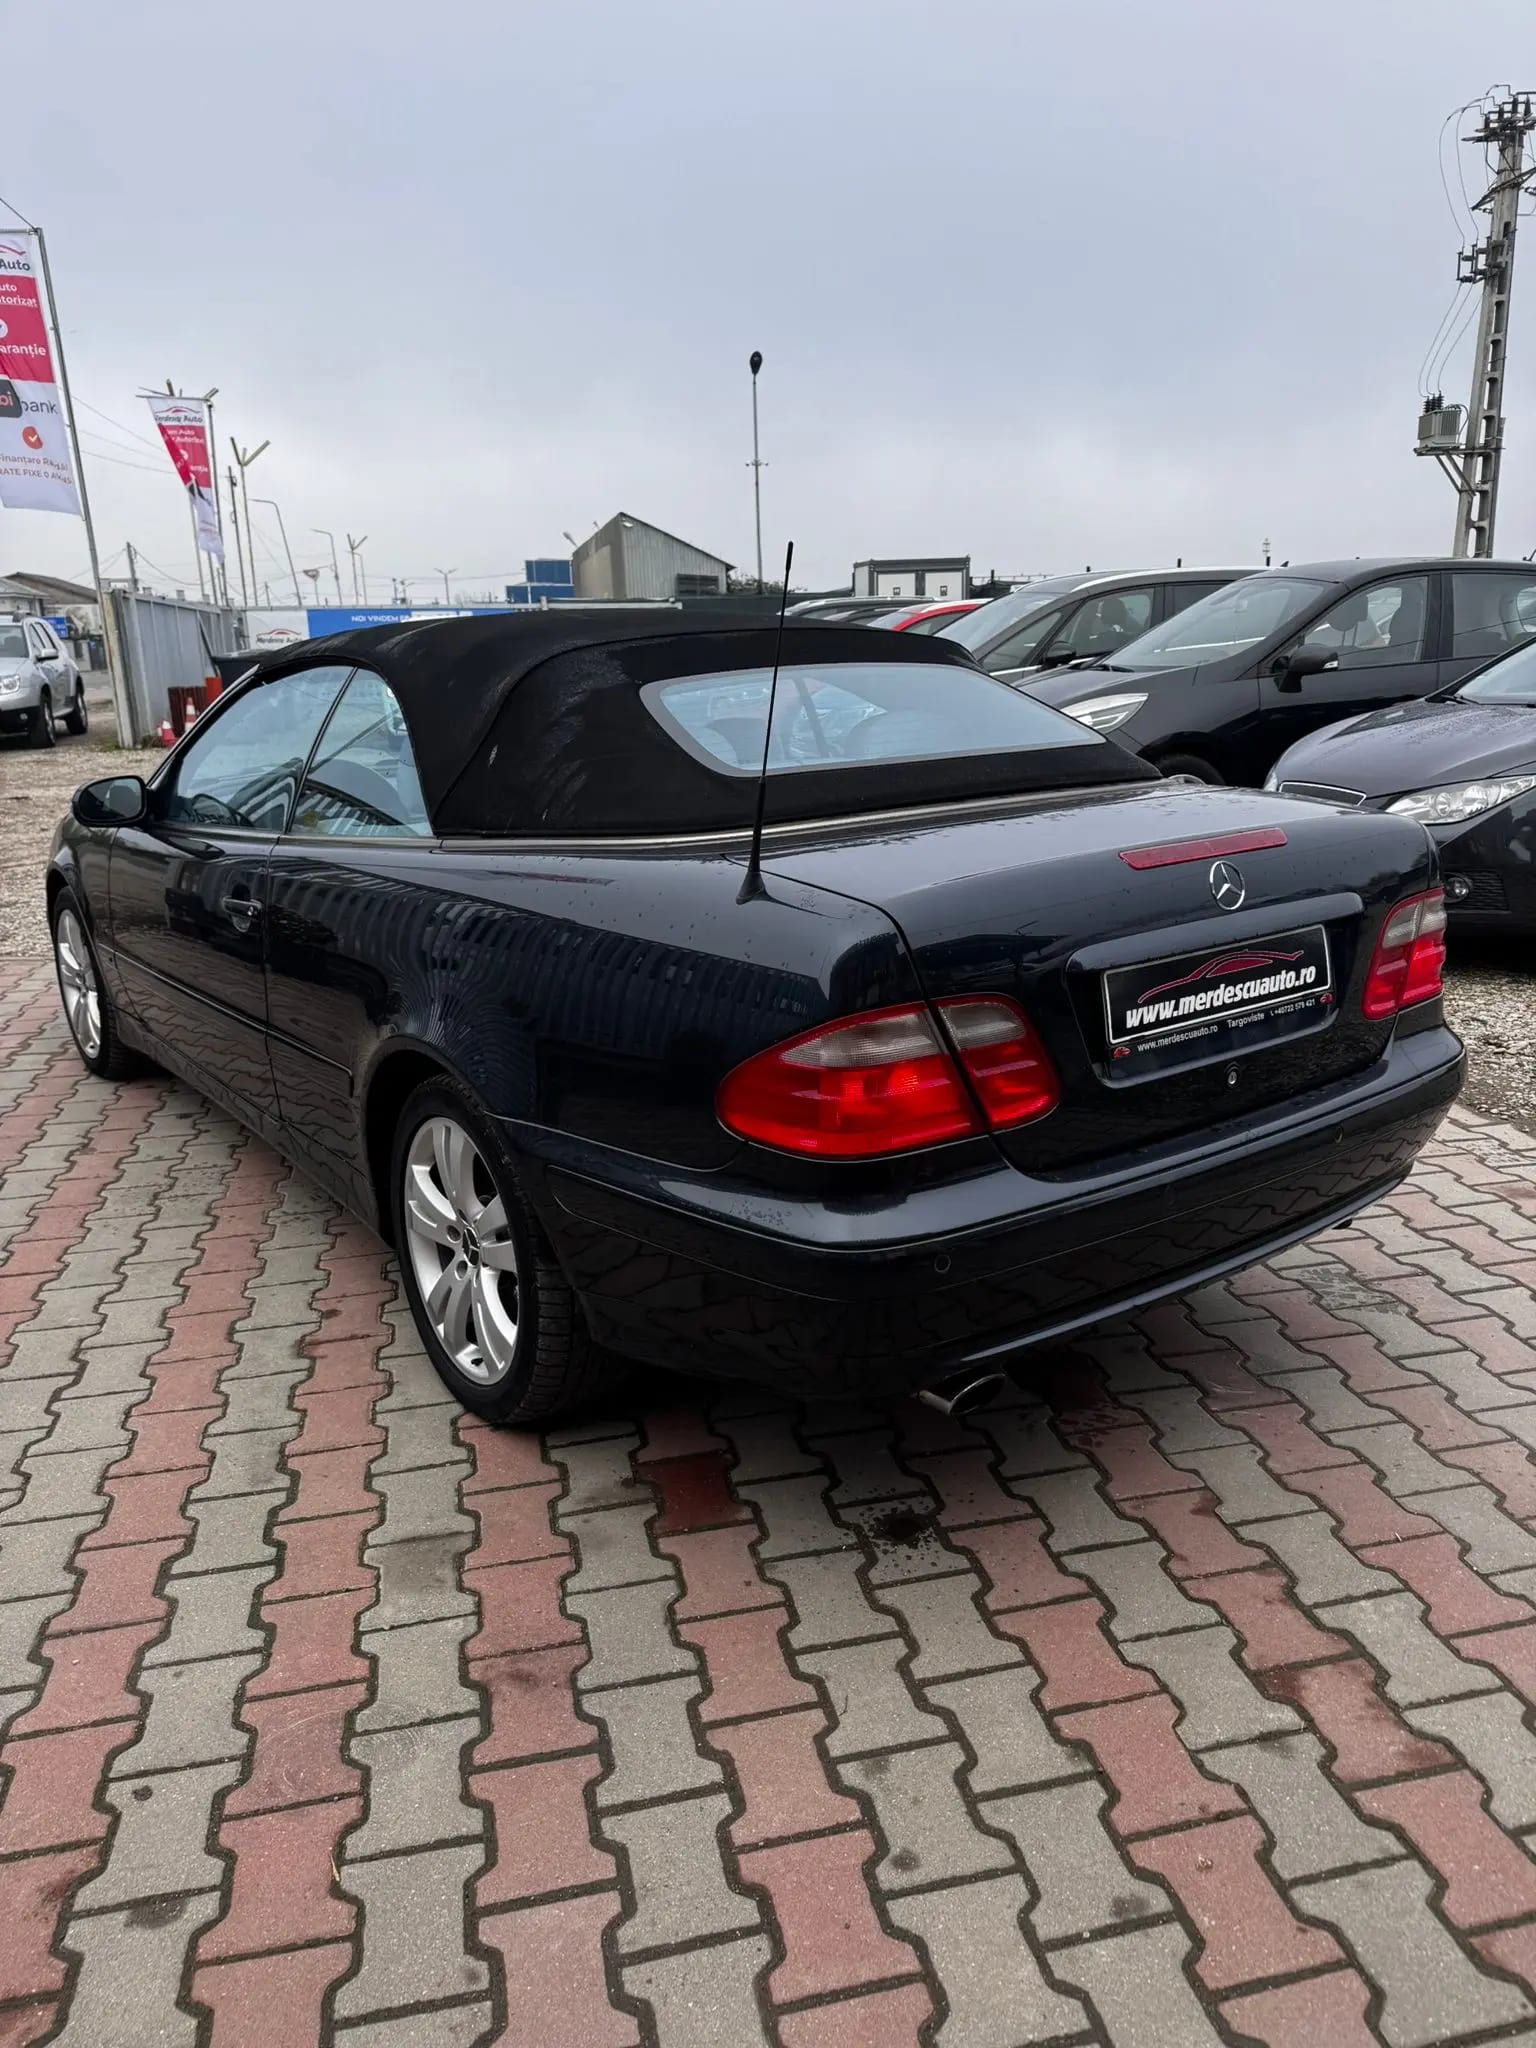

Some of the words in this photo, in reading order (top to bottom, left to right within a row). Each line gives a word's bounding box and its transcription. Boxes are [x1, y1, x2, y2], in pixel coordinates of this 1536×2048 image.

[0, 258, 31, 271] Auto
[0, 343, 46, 358] aranție
[1126, 965, 1316, 1029] www.merdescuauto.ro
[1137, 1025, 1218, 1052] www.merdescuauto.ro
[1227, 1012, 1265, 1029] Targoviste
